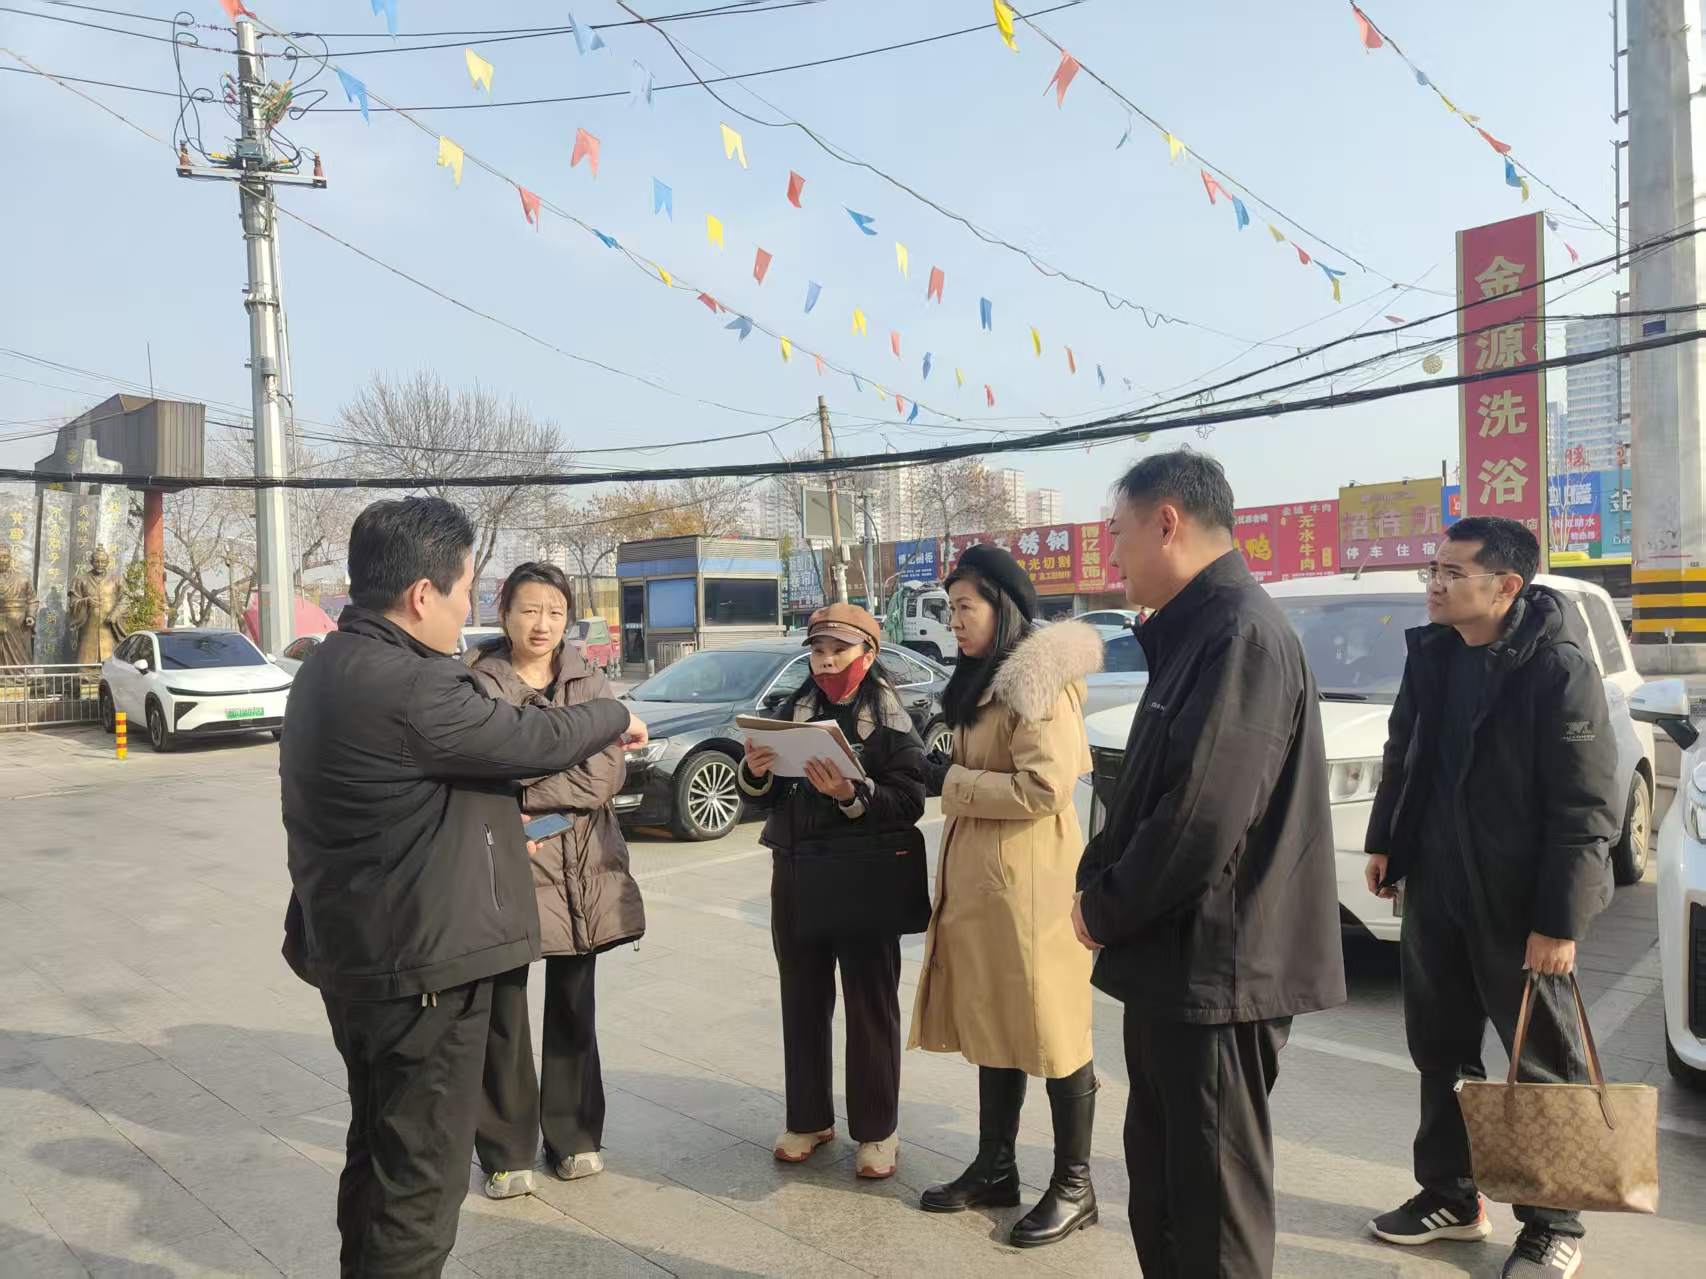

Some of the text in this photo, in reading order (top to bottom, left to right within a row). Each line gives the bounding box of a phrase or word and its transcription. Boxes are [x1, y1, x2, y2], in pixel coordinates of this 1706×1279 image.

[1474, 255, 1528, 505] 金源洗浴
[1345, 542, 1438, 561] 停车住宿
